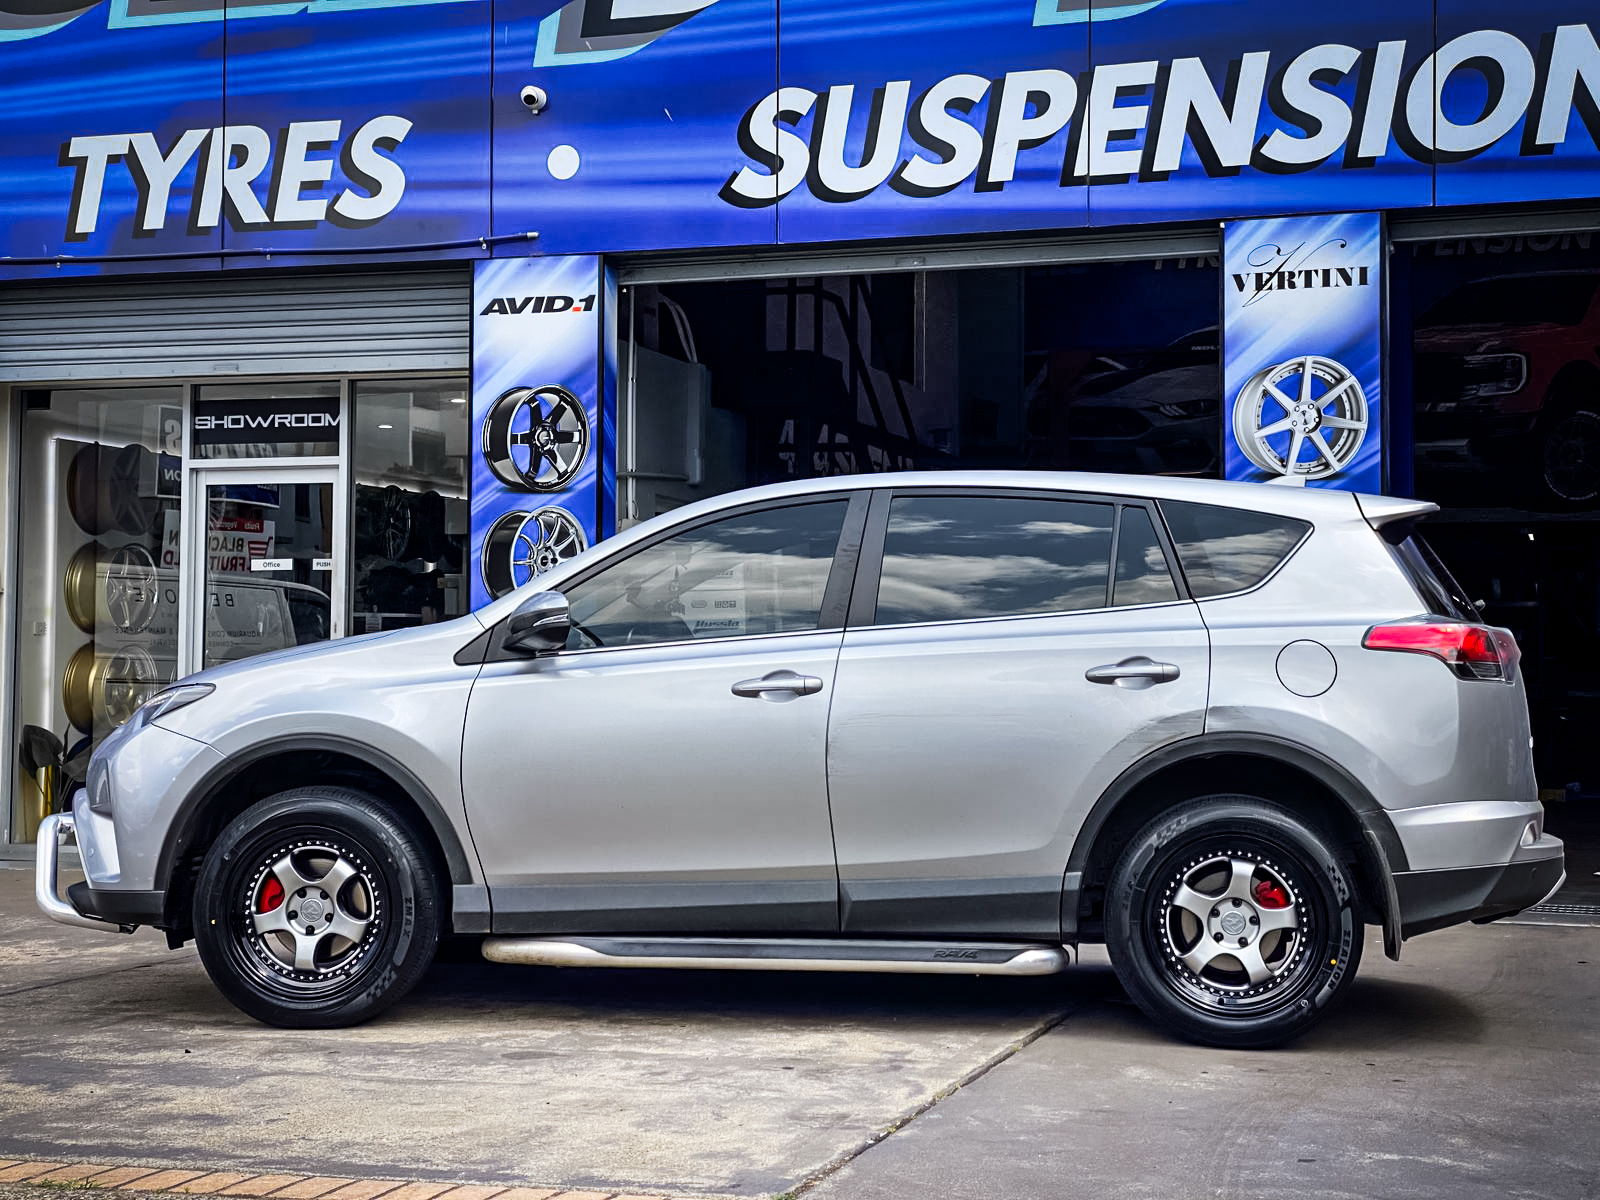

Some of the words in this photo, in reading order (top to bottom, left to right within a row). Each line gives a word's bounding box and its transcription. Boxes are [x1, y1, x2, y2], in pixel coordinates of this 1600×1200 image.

[66, 115, 413, 235] TYRES
[1232, 266, 1369, 292] VERTINI
[480, 295, 596, 315] AVID.1
[195, 413, 340, 429] SHOWROOM
[933, 949, 979, 959] RAV4
